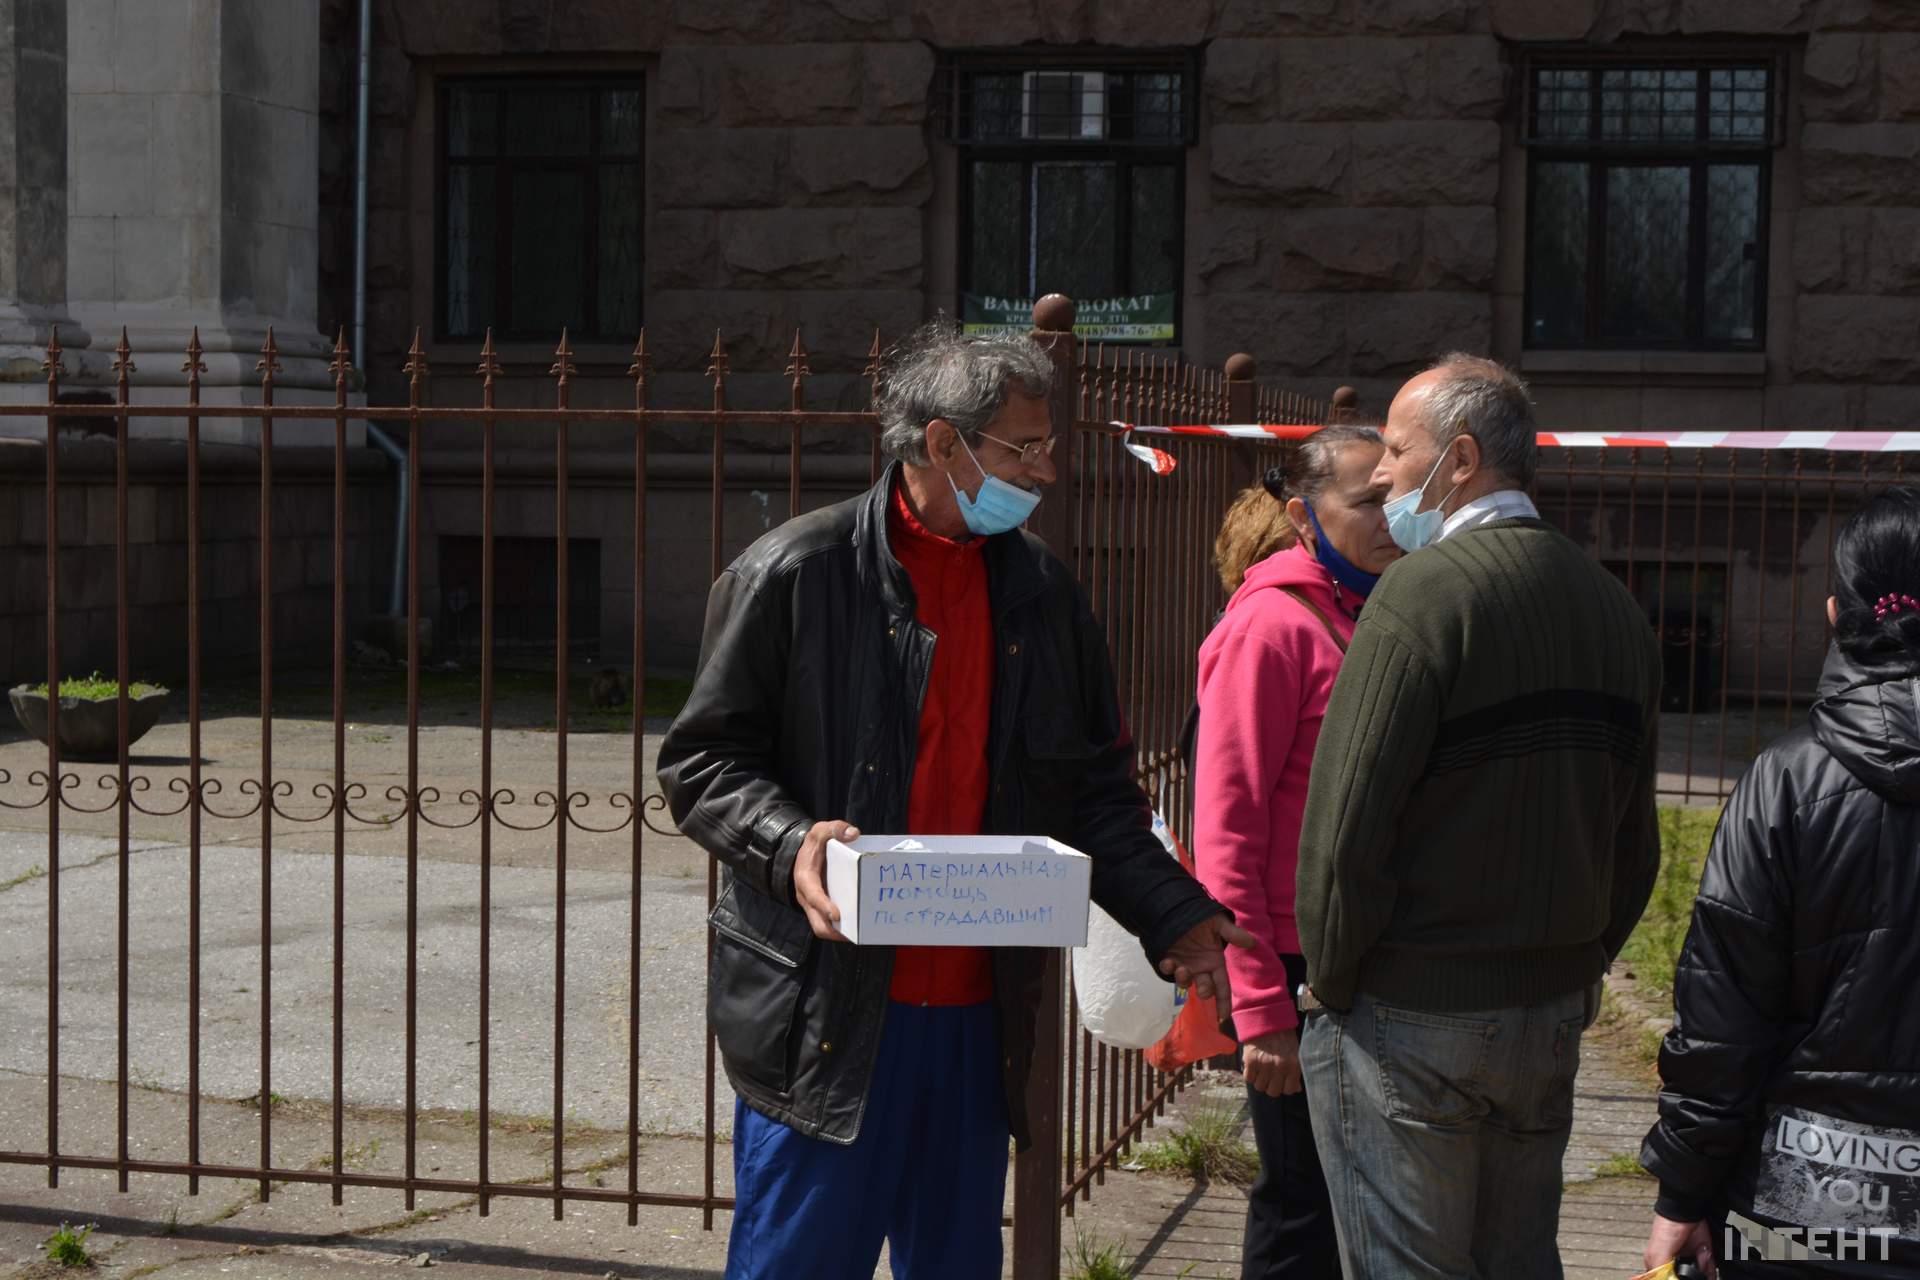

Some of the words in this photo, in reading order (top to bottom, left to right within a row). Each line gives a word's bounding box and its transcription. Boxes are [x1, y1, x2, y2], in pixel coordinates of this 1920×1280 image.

[1078, 295, 1154, 313] ВОКАТ
[1781, 1120, 1920, 1173] LOVING
[1806, 1173, 1890, 1211] YOU
